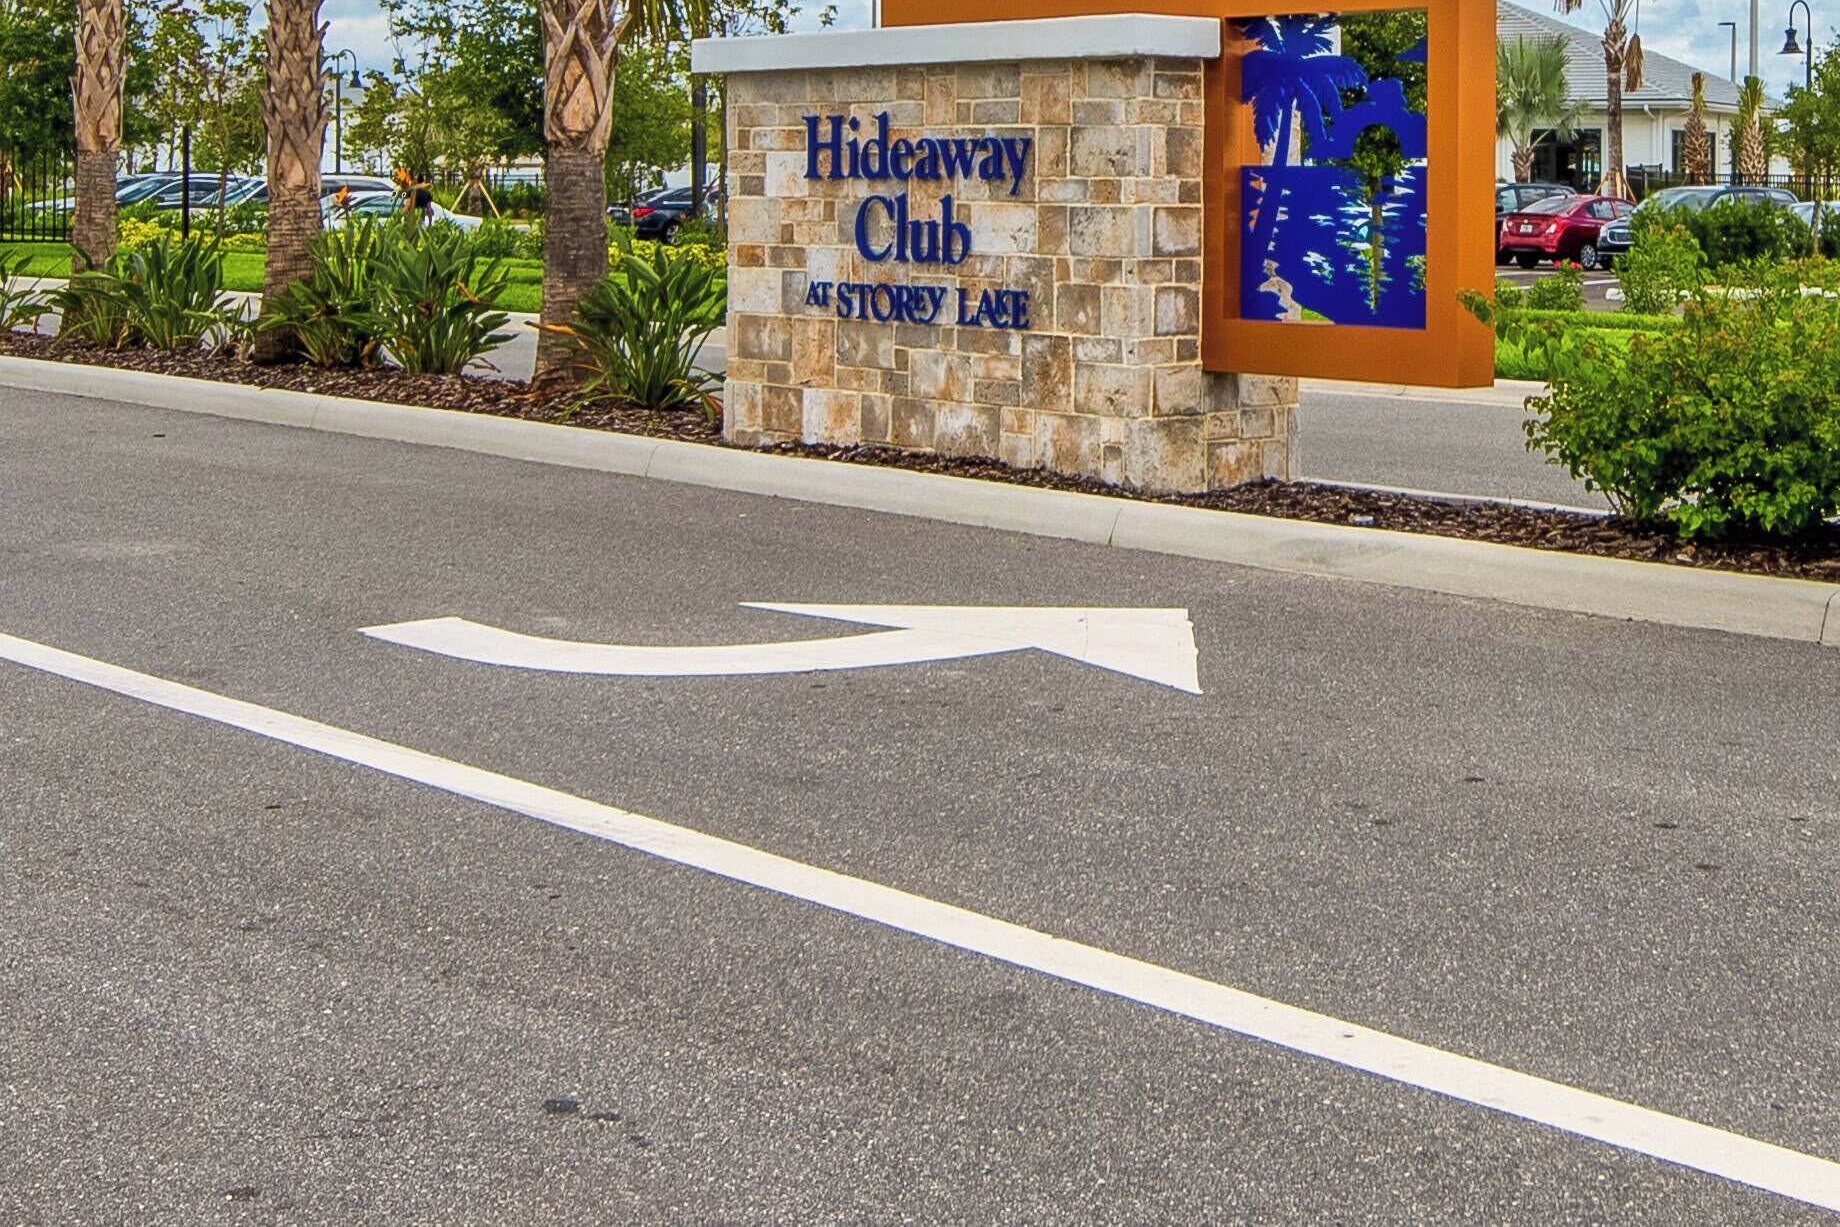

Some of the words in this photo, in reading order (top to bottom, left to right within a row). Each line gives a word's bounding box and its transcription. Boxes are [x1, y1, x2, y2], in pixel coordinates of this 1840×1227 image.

[802, 111, 1032, 195] Hideaway
[855, 192, 972, 265] Club
[806, 280, 833, 307] AT
[836, 281, 948, 324] STOREY
[956, 287, 1030, 329] LAKE
